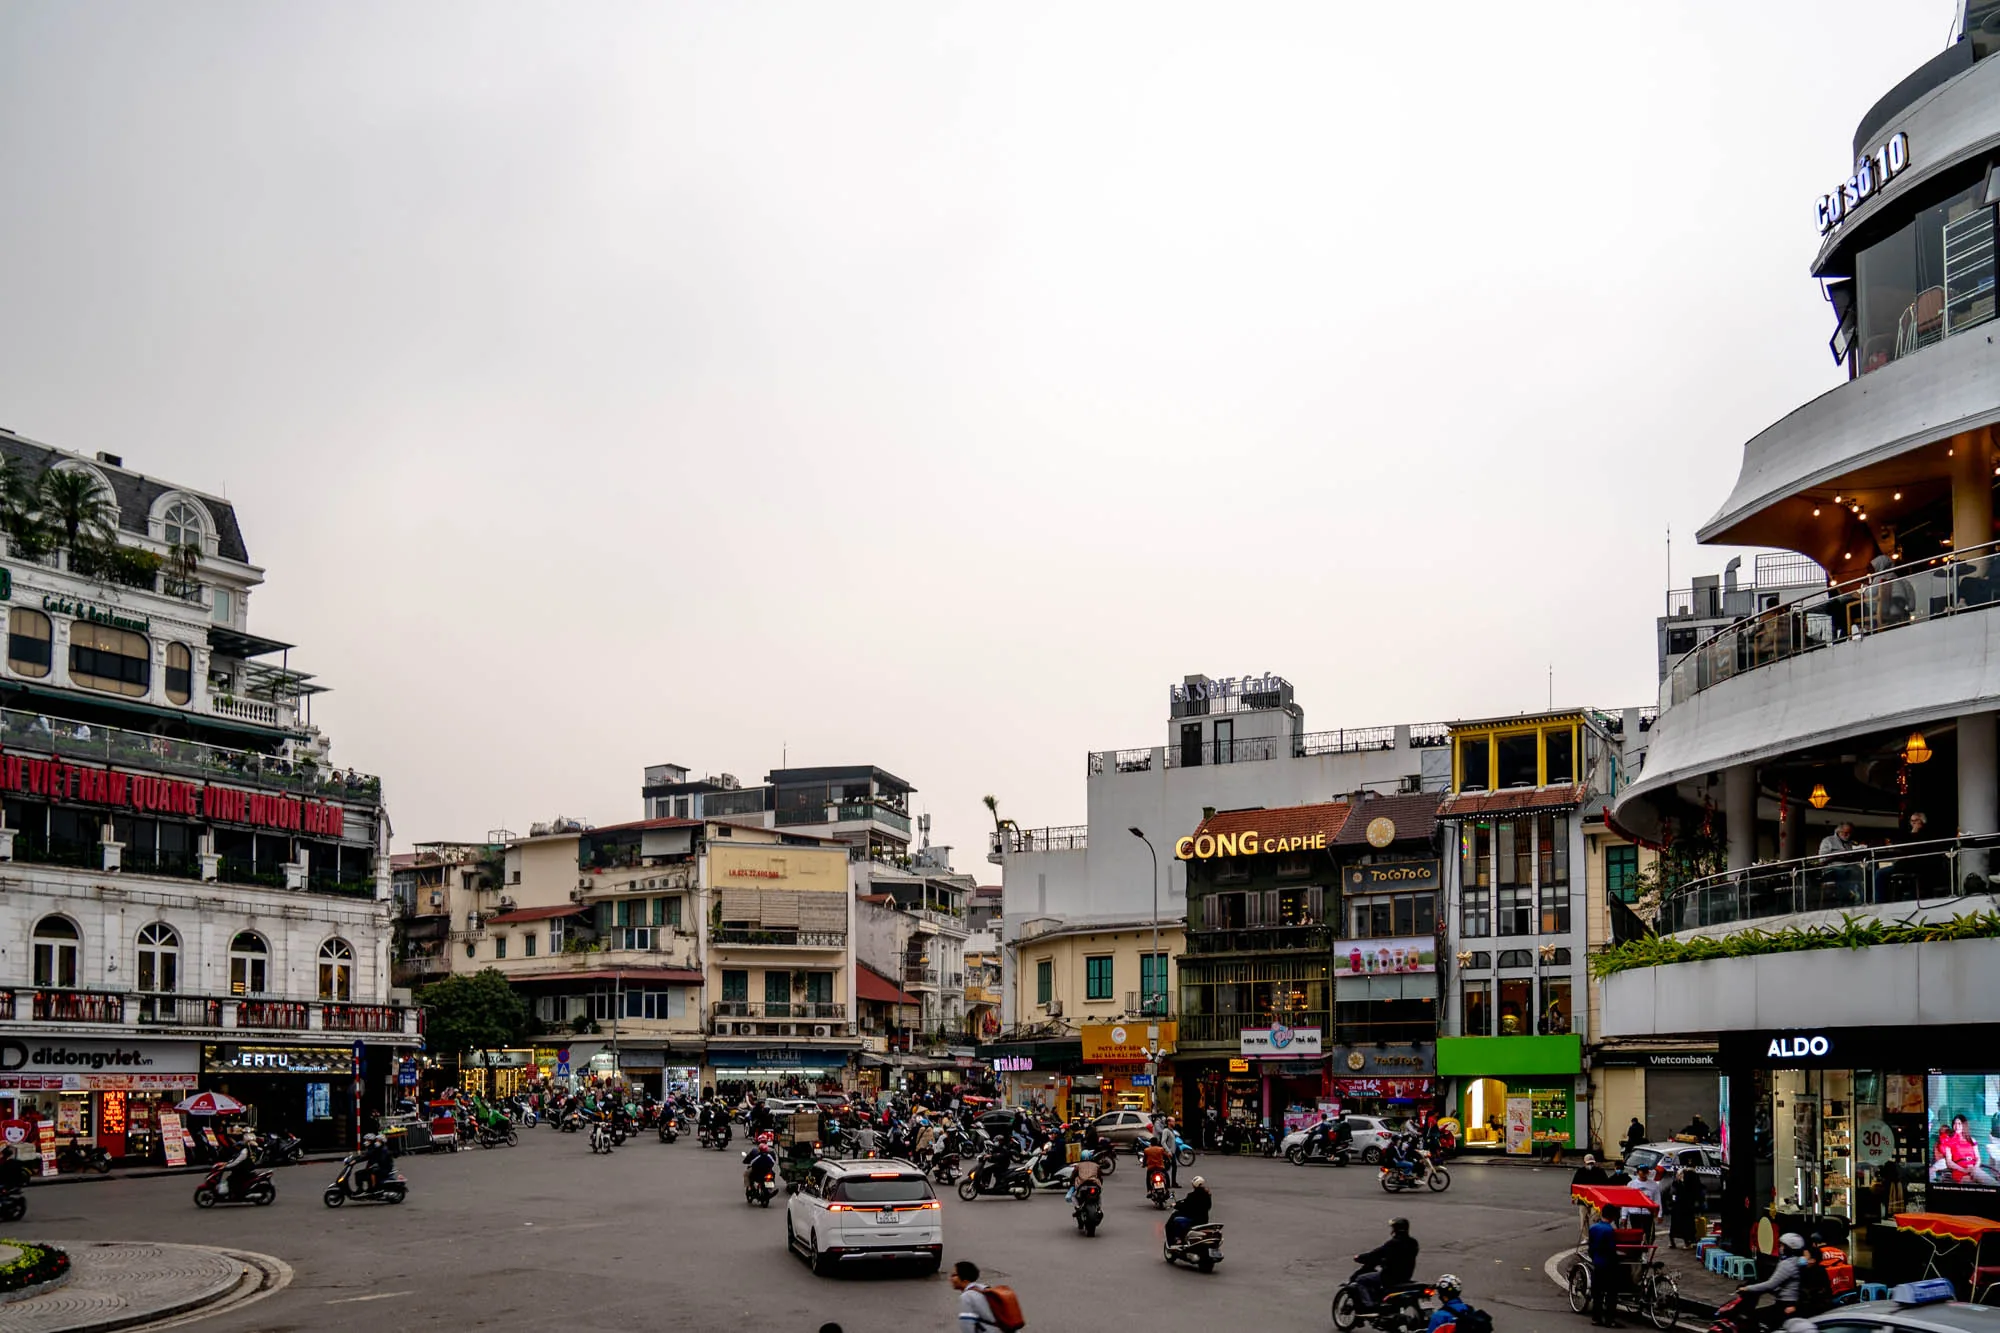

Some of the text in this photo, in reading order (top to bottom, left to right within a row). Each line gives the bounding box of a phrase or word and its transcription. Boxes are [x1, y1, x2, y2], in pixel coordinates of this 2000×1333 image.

[1876, 131, 1910, 183] 10
[76, 602, 84, 619] &
[88, 605, 150, 632] Restaurant
[1170, 684, 1191, 704] LA
[28, 753, 74, 804] VIỆT
[79, 767, 127, 806] NAM
[131, 774, 197, 816] QUANG
[203, 785, 246, 822] VINH
[249, 790, 300, 830] MUÔN
[304, 797, 344, 837] NĂM
[1175, 828, 1259, 864] CỘNG
[1650, 1055, 1713, 1065] Vietcombank
[1767, 1036, 1829, 1057] ALDO
